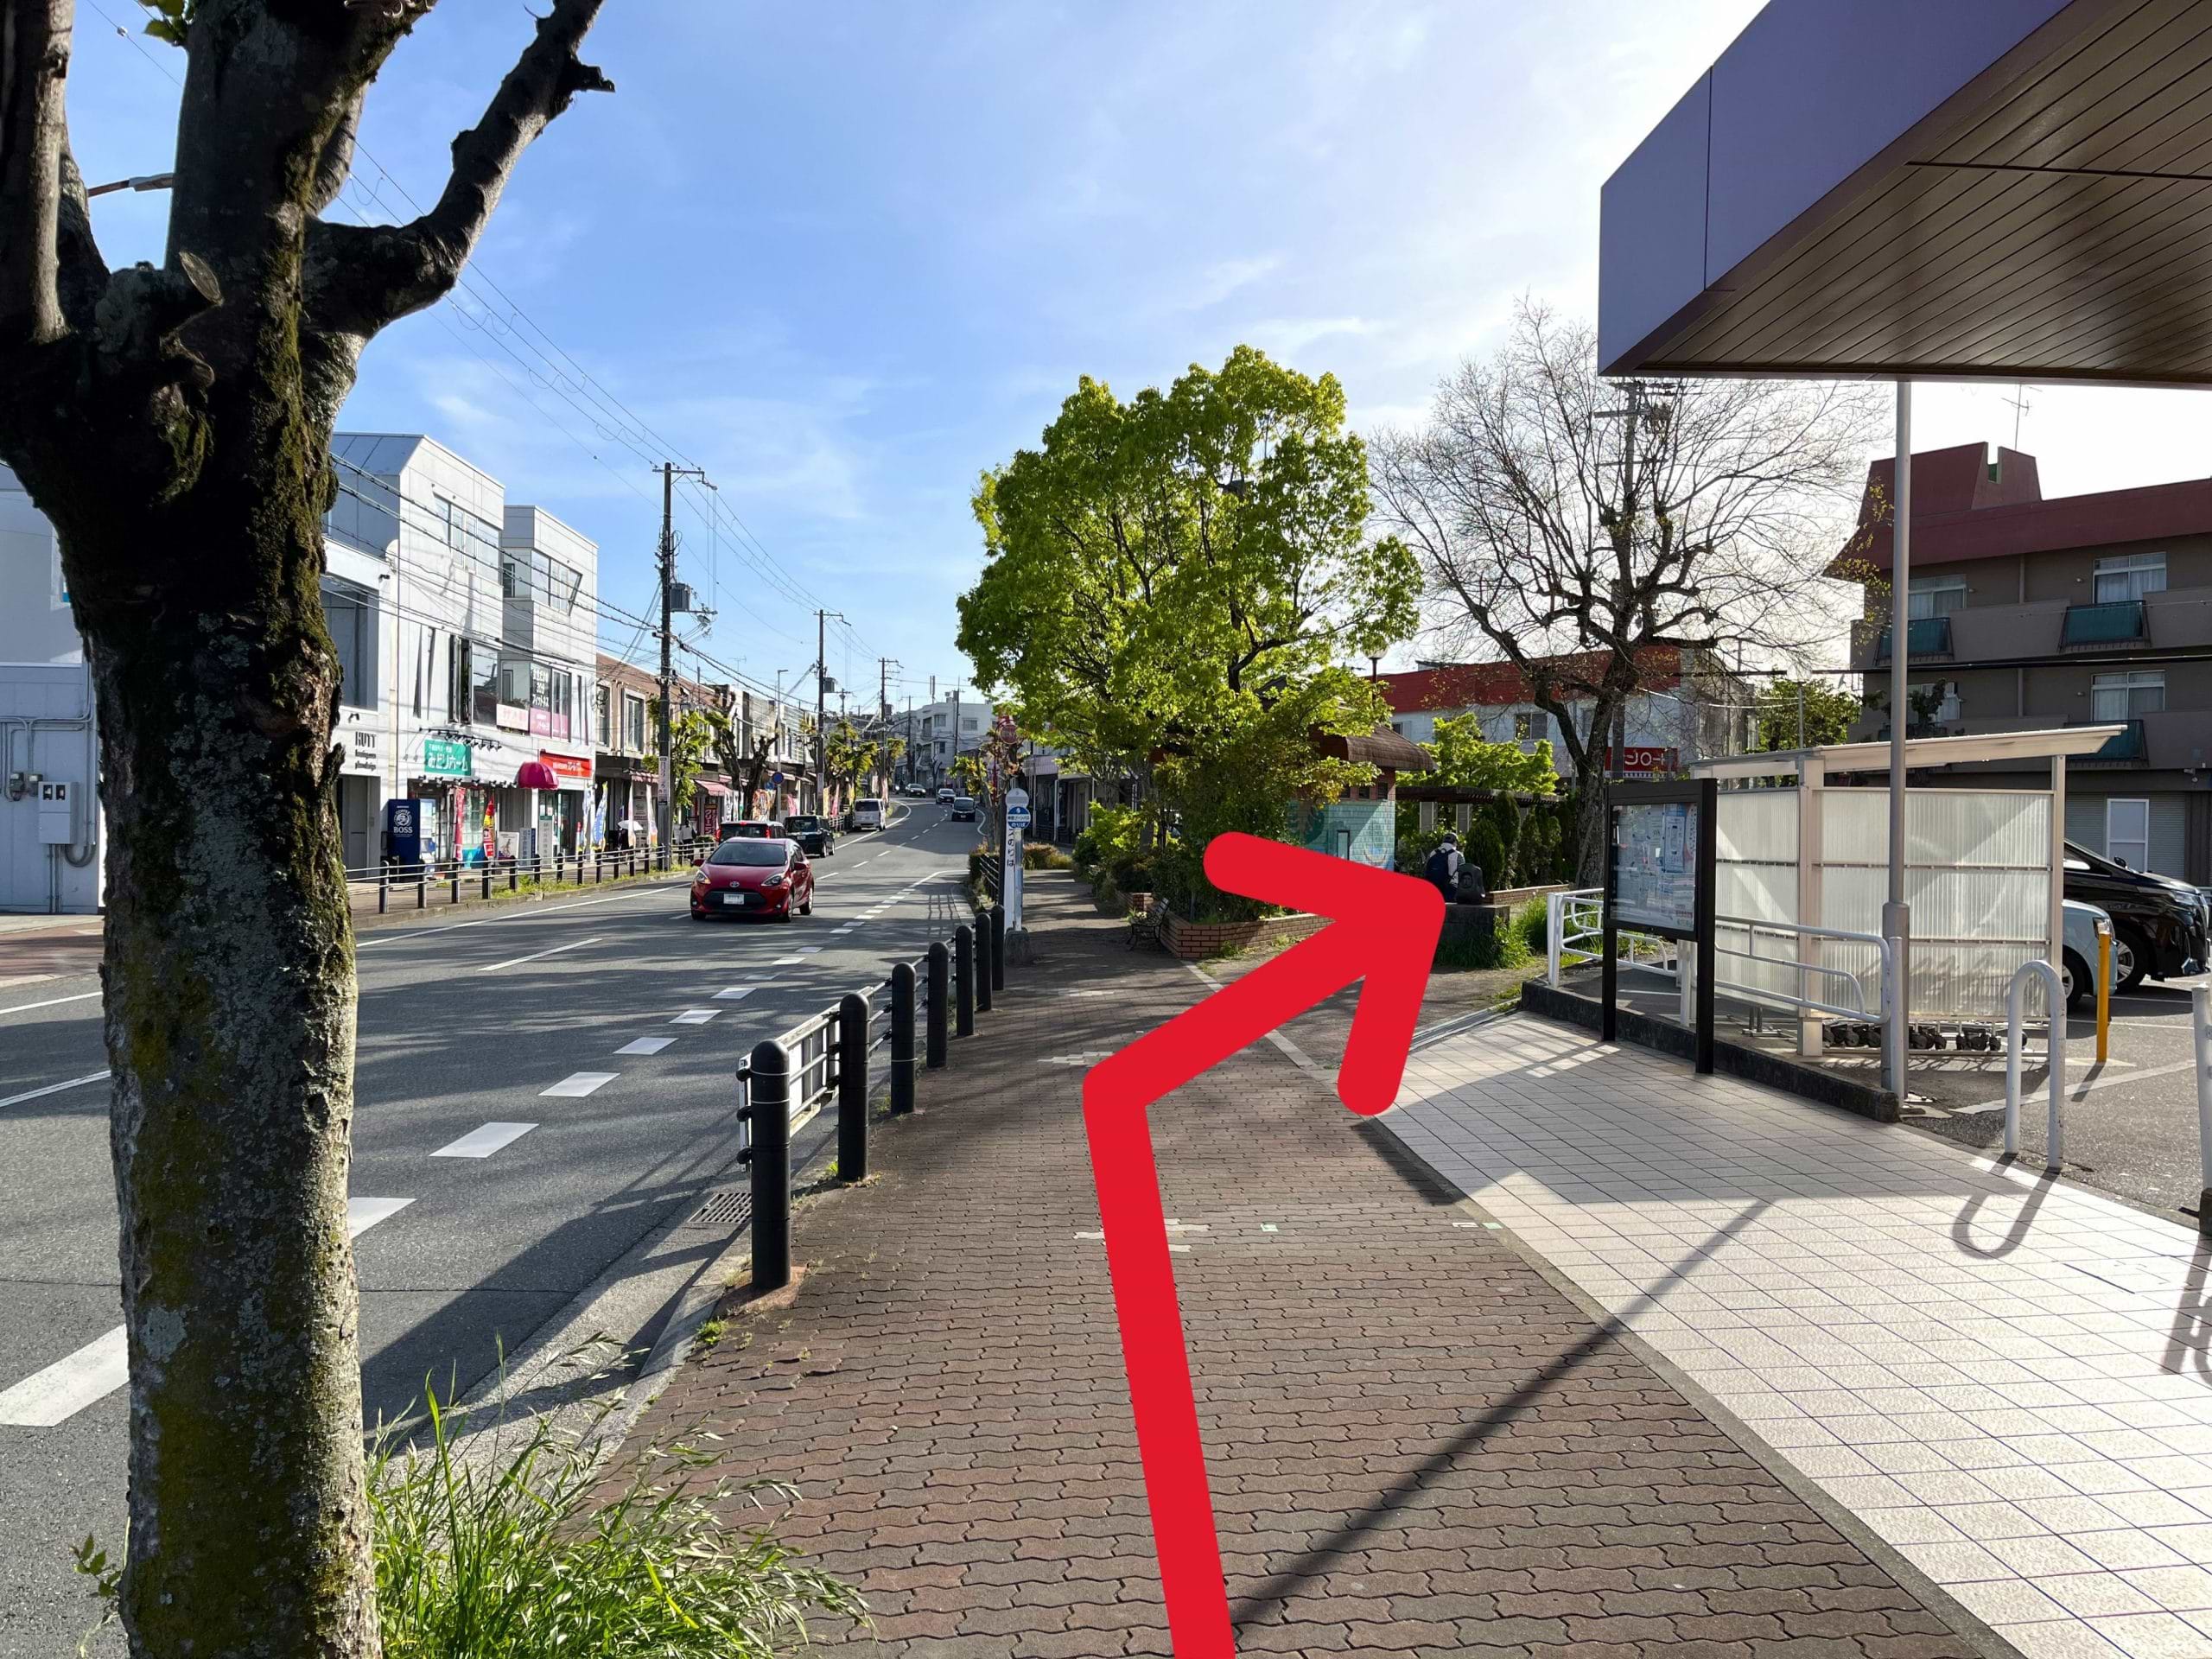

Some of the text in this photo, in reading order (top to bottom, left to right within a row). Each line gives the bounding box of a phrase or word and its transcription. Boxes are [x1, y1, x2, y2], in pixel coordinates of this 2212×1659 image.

[428, 752, 468, 772] みどりホーム
